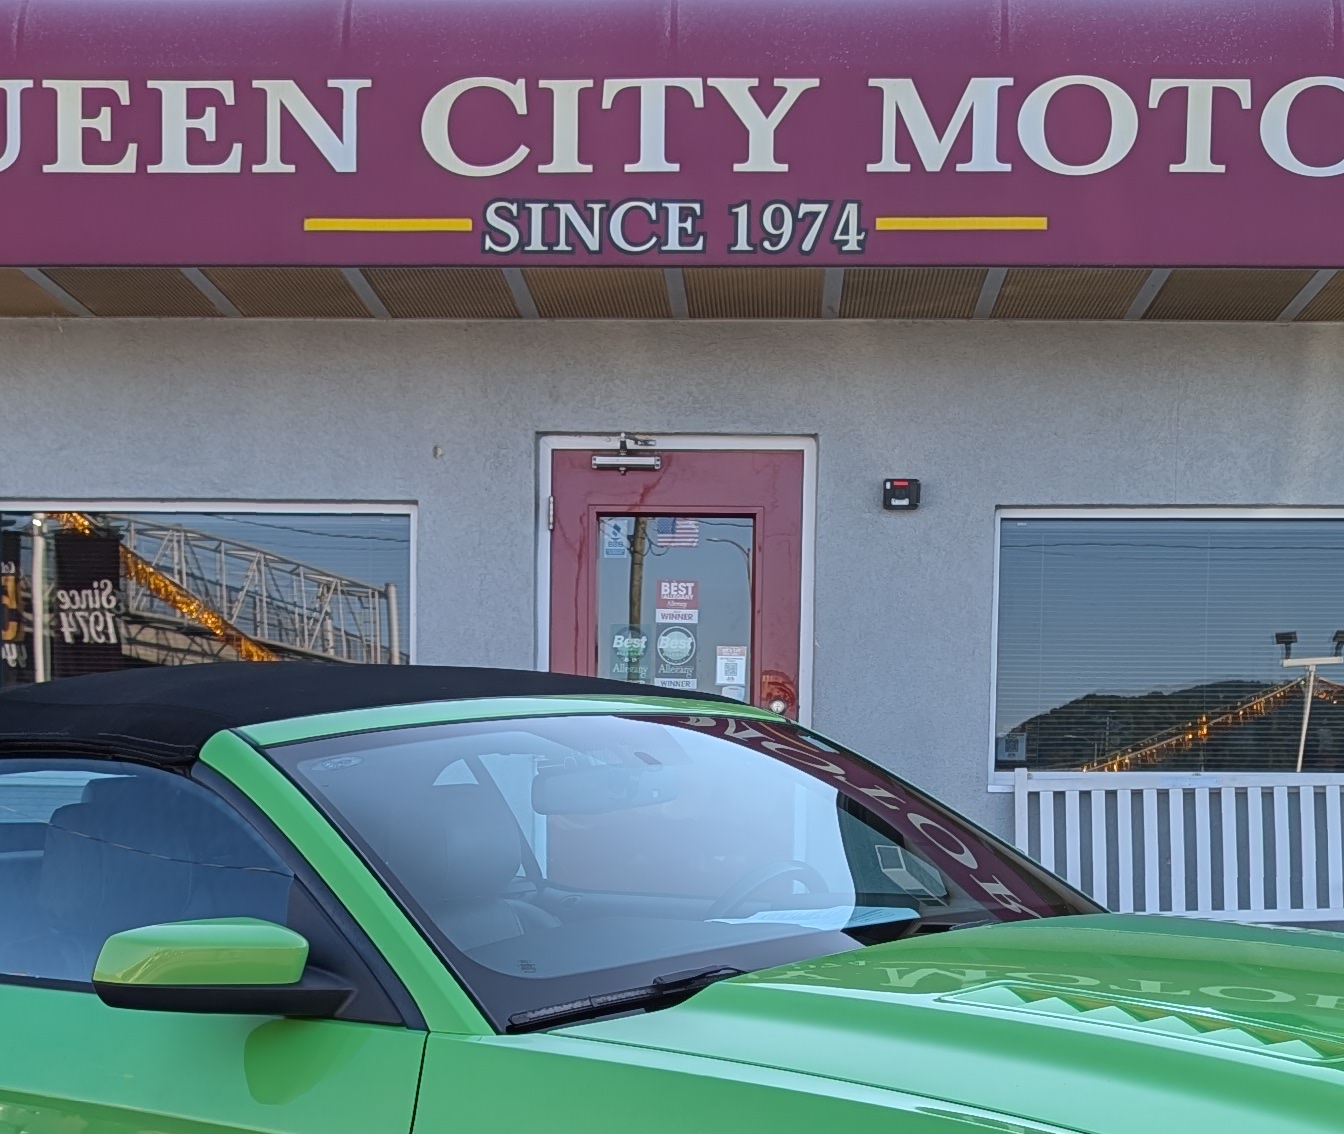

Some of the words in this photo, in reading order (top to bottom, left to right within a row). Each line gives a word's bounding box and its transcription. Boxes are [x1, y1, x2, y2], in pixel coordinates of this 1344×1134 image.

[420, 76, 821, 178] CITY
[480, 199, 706, 256] SINCE
[726, 199, 866, 256] 1974
[661, 613, 694, 621] WINNER
[612, 635, 648, 648] Best
[659, 636, 693, 649] Best
[660, 680, 691, 688] WINNER
